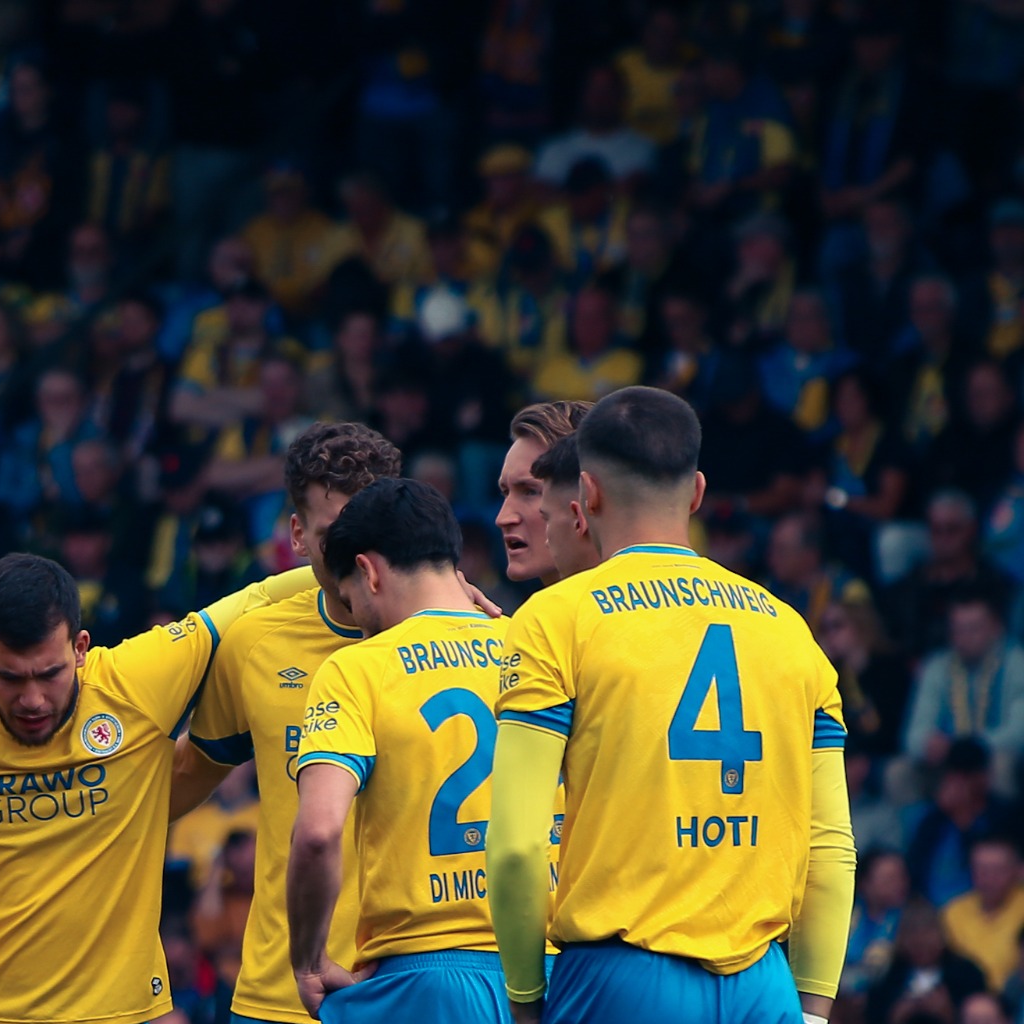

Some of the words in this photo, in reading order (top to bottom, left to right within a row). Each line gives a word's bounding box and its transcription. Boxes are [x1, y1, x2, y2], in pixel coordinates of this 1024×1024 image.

[591, 577, 777, 617] BRAUNSCHWEIG
[668, 623, 763, 795] 4
[676, 815, 759, 848] HOTI
[429, 872, 450, 904] DI
